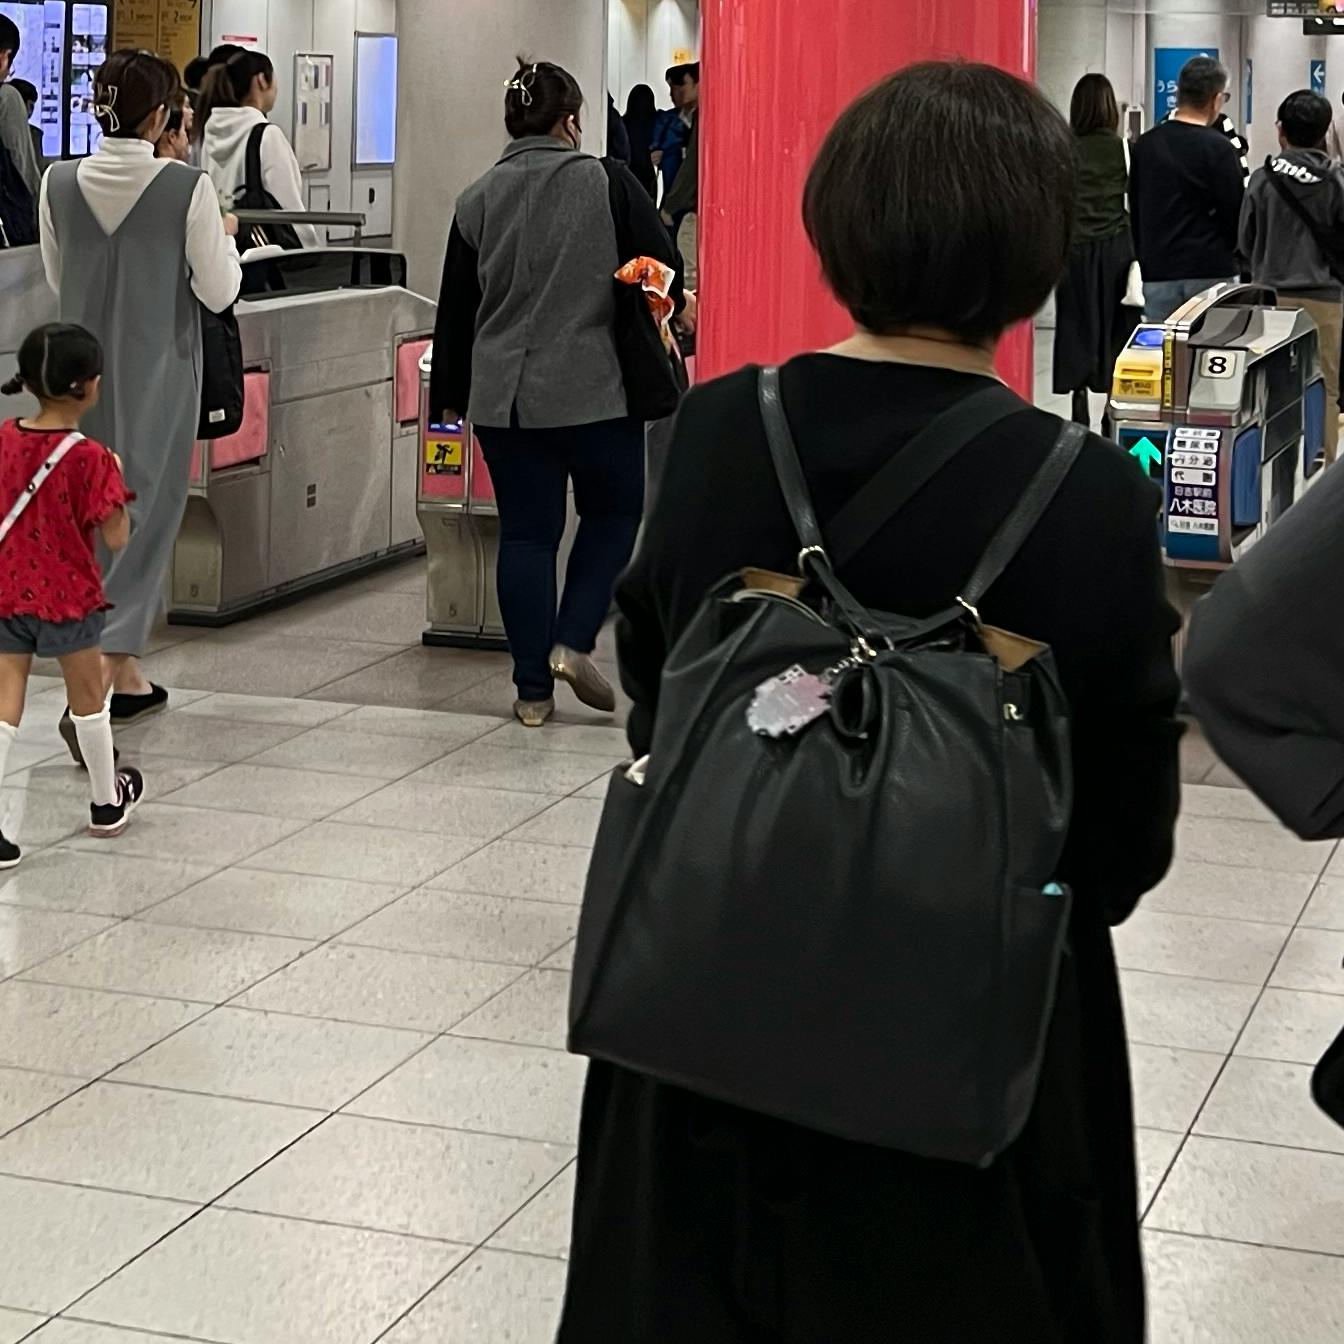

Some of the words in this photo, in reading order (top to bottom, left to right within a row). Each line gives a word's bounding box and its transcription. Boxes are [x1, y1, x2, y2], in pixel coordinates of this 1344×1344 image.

[1208, 356, 1227, 374] 8
[1169, 497, 1217, 516] 八木医院
